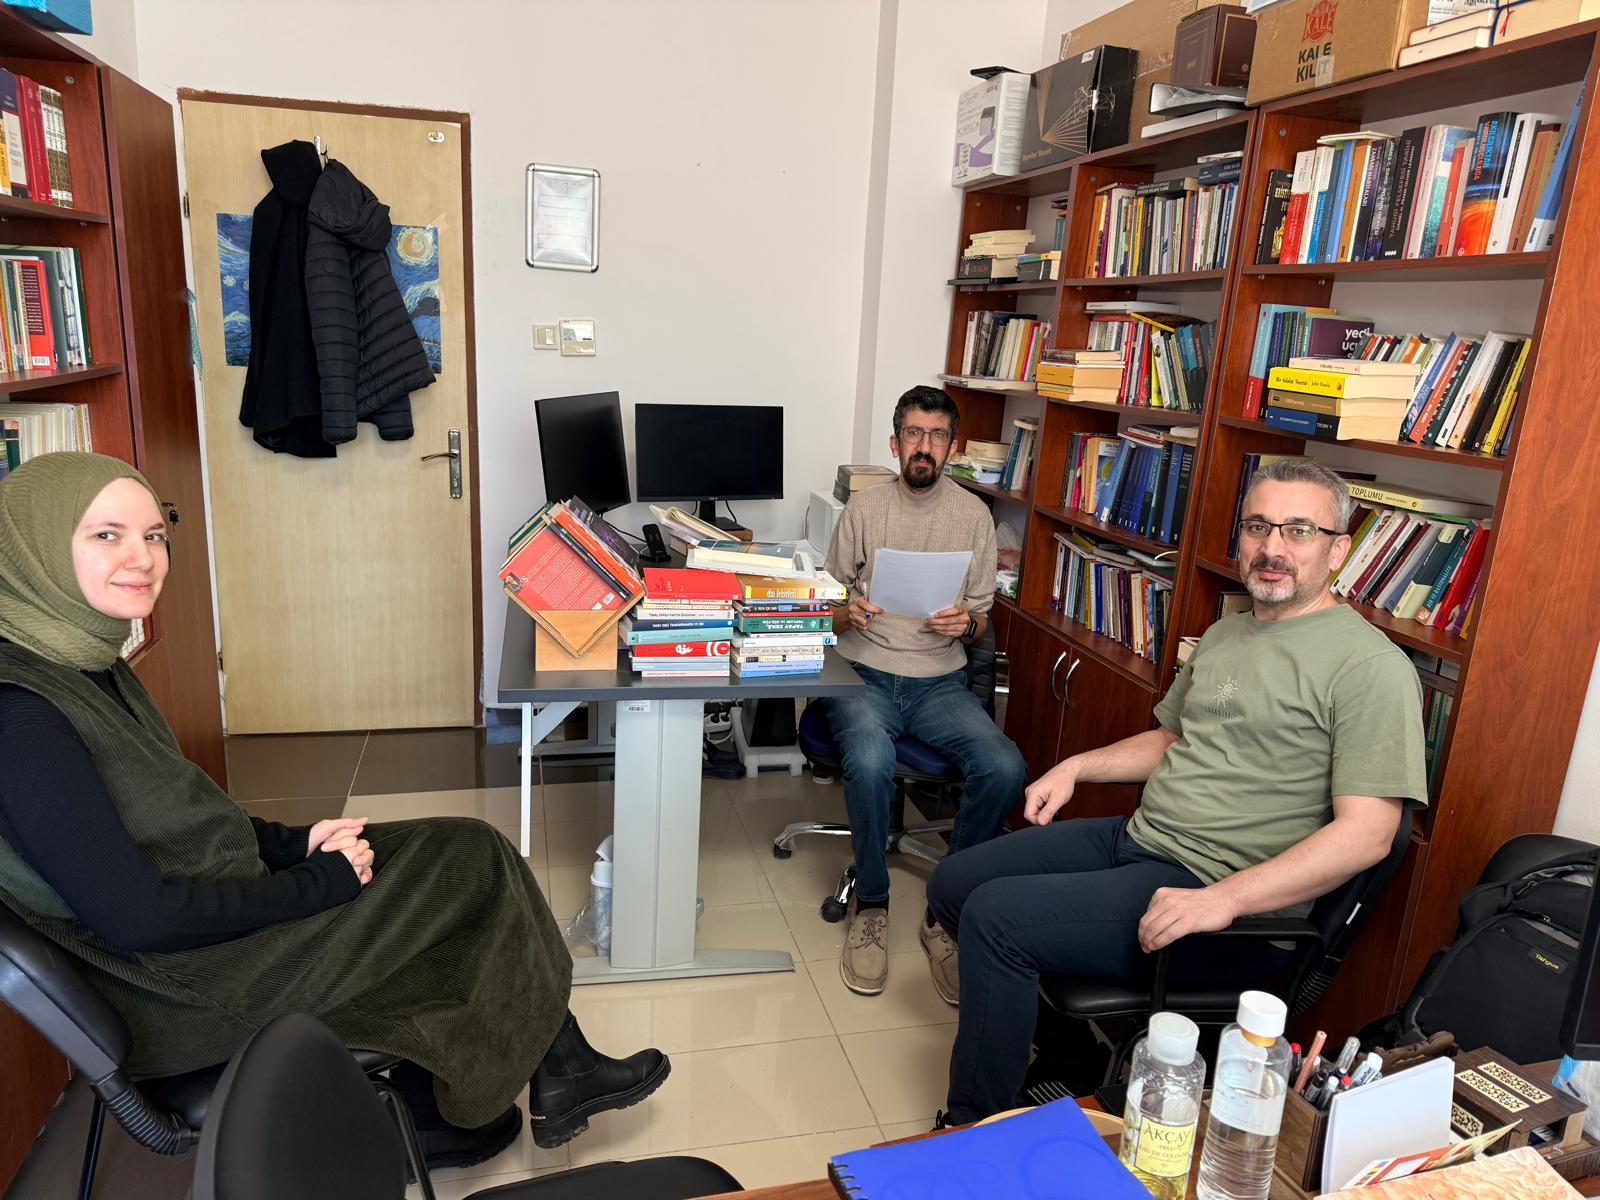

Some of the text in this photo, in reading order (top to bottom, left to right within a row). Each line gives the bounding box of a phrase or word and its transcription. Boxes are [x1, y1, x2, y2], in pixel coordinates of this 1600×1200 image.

[1351, 486, 1384, 501] TOPLUMU
[1424, 596, 1434, 608] DİN
[1432, 564, 1453, 594] RASYONALİTE
[1535, 953, 1559, 970] Targus
[1143, 1123, 1190, 1147] AKÇAY
